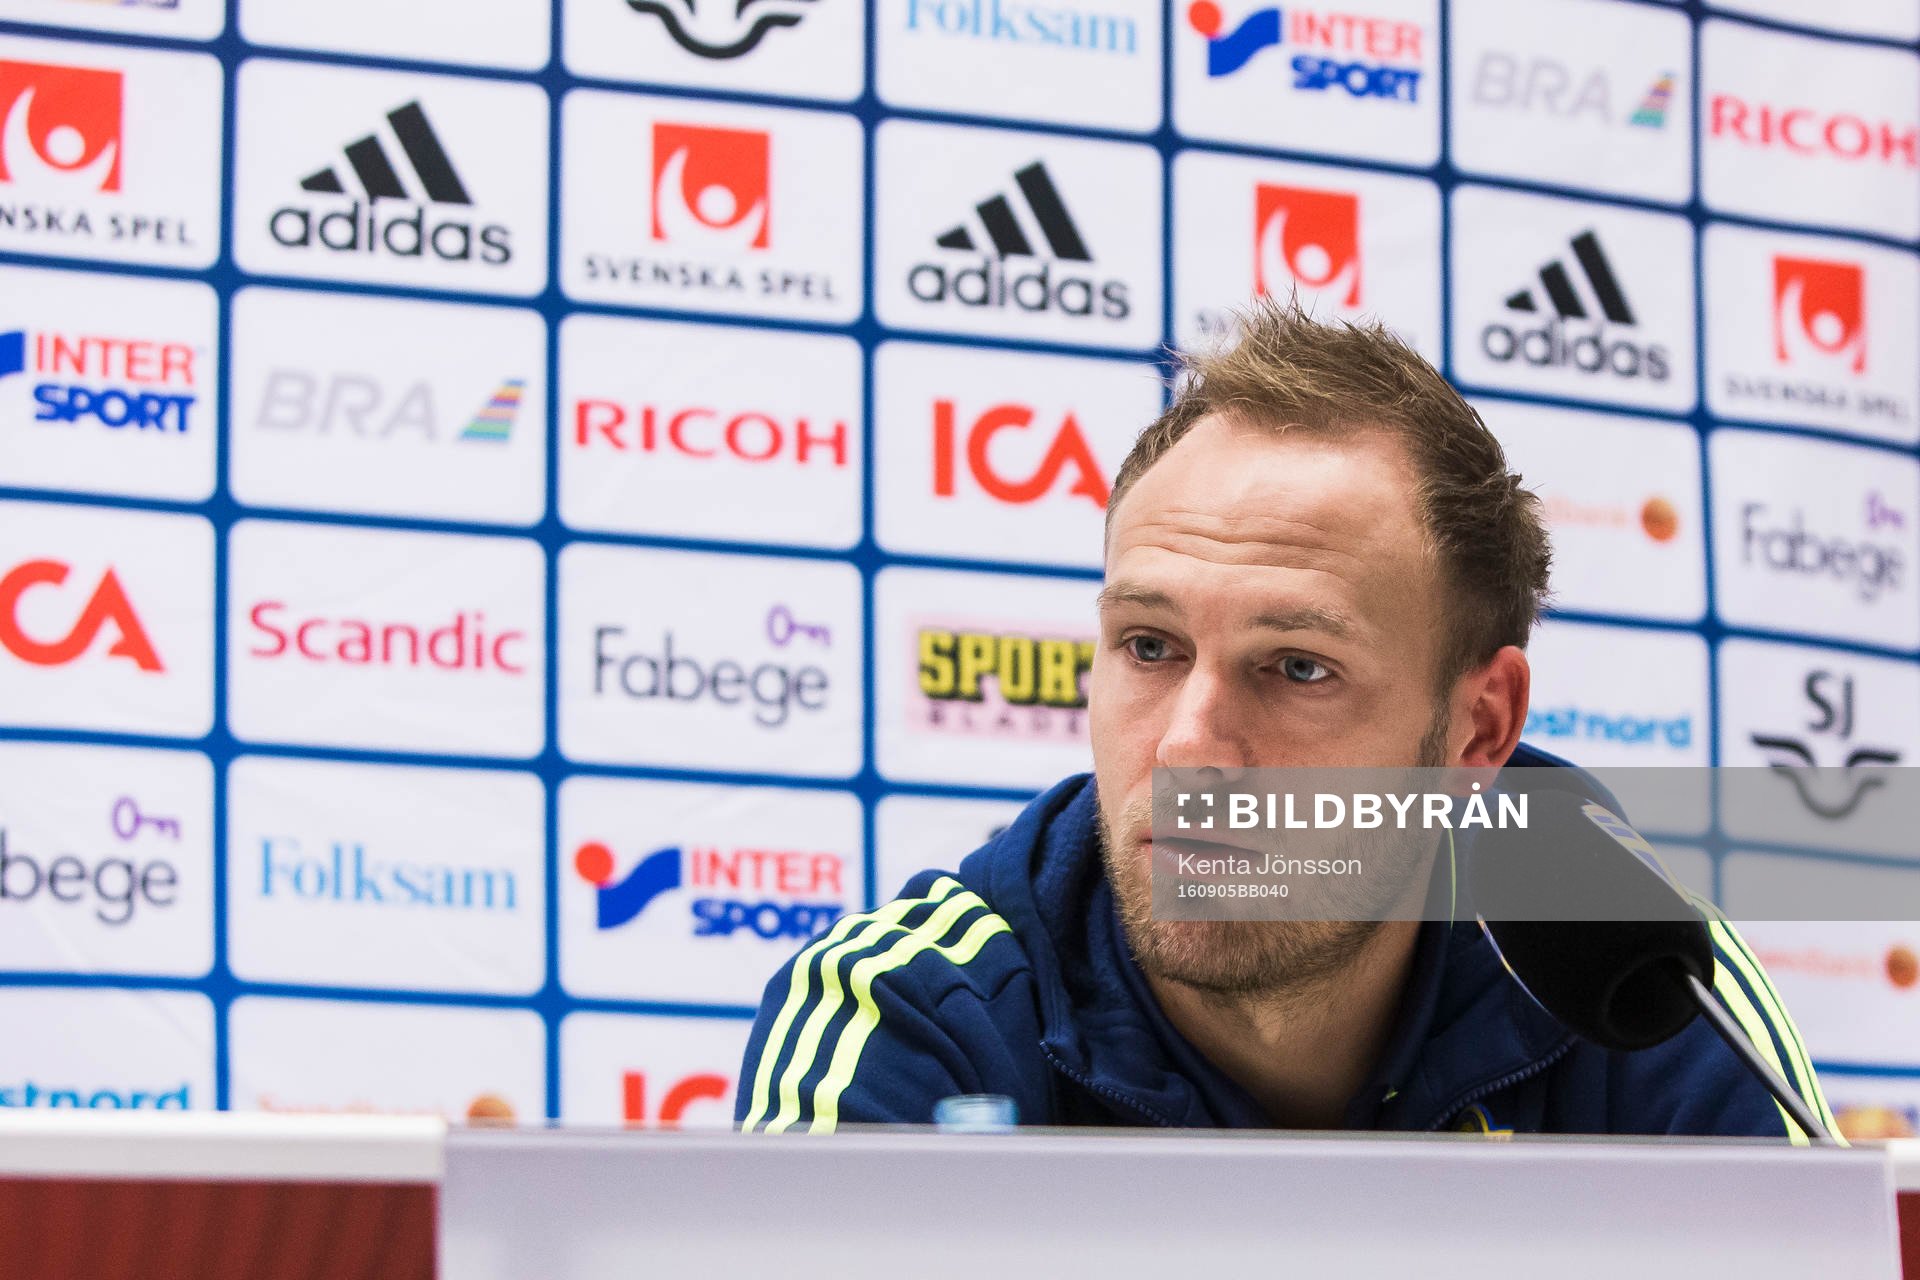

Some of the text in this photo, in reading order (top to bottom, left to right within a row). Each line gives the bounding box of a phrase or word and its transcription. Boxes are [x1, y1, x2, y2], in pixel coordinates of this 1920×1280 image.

[1291, 12, 1421, 61] INTER
[1290, 55, 1422, 103] SPORT
[1472, 48, 1615, 124] BRA
[1710, 94, 1918, 169] RICOH
[109, 213, 192, 245] SPEL
[269, 202, 512, 266] adidas
[585, 255, 837, 301] SVENSKA SPEL
[907, 262, 1132, 320] adidas
[34, 332, 195, 386] INTER
[1481, 320, 1670, 383] adidas
[33, 382, 196, 434] SPORT
[254, 366, 438, 442] BRA
[575, 400, 848, 467] RICOH
[933, 400, 1111, 510] ICA
[1741, 499, 1906, 604] Fabege
[249, 600, 524, 675] Scandic
[593, 626, 830, 728] Fabege
[1803, 669, 1855, 739] SJ
[1523, 709, 1692, 750] ostnord
[258, 837, 518, 911] Folksam
[690, 849, 842, 895] INTER
